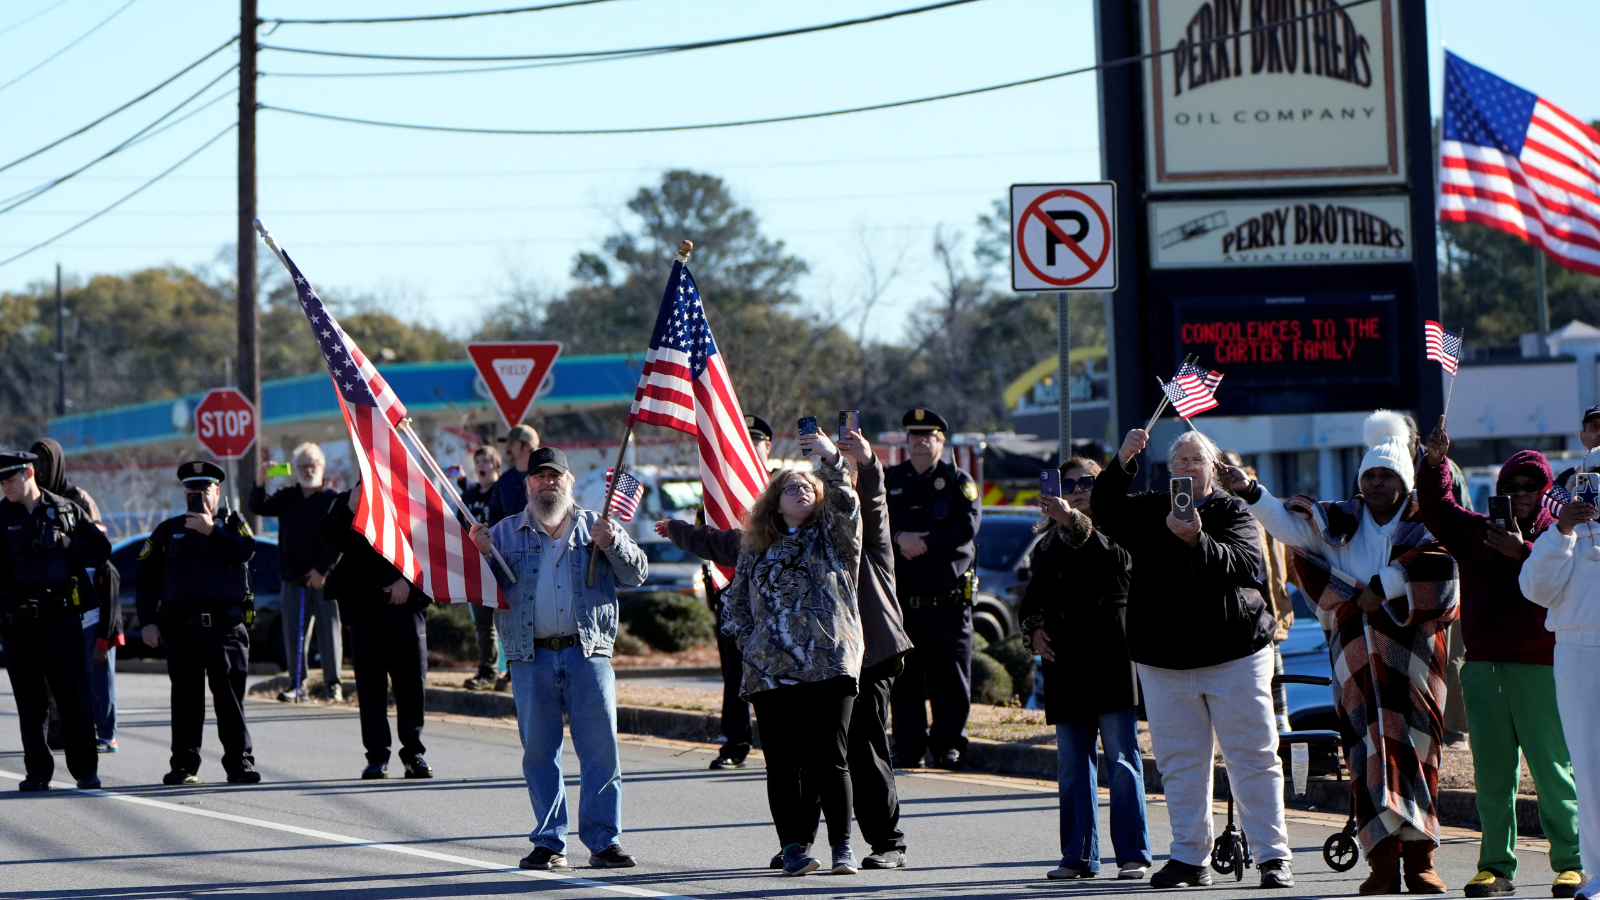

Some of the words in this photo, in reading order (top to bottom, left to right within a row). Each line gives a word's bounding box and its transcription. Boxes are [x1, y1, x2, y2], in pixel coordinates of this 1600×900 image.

[1173, 0, 1242, 97] PERRY
[1249, 0, 1372, 88] BROTHERS
[1174, 112, 1221, 125] OIL
[1233, 107, 1375, 124] COMPANY
[1046, 210, 1090, 266] P
[1222, 206, 1291, 254] PERRY
[1294, 203, 1405, 249] BROTHERS
[1223, 252, 1331, 263] AVIATION
[1340, 250, 1404, 260] FUELS
[1181, 320, 1301, 344] CONDOLENCES
[1312, 319, 1336, 340] TO
[1346, 317, 1380, 339] THE
[1214, 340, 1283, 363] CARTER
[1293, 338, 1355, 361] FAMILY
[500, 365, 527, 375] YIELD
[201, 410, 251, 437] STOP
